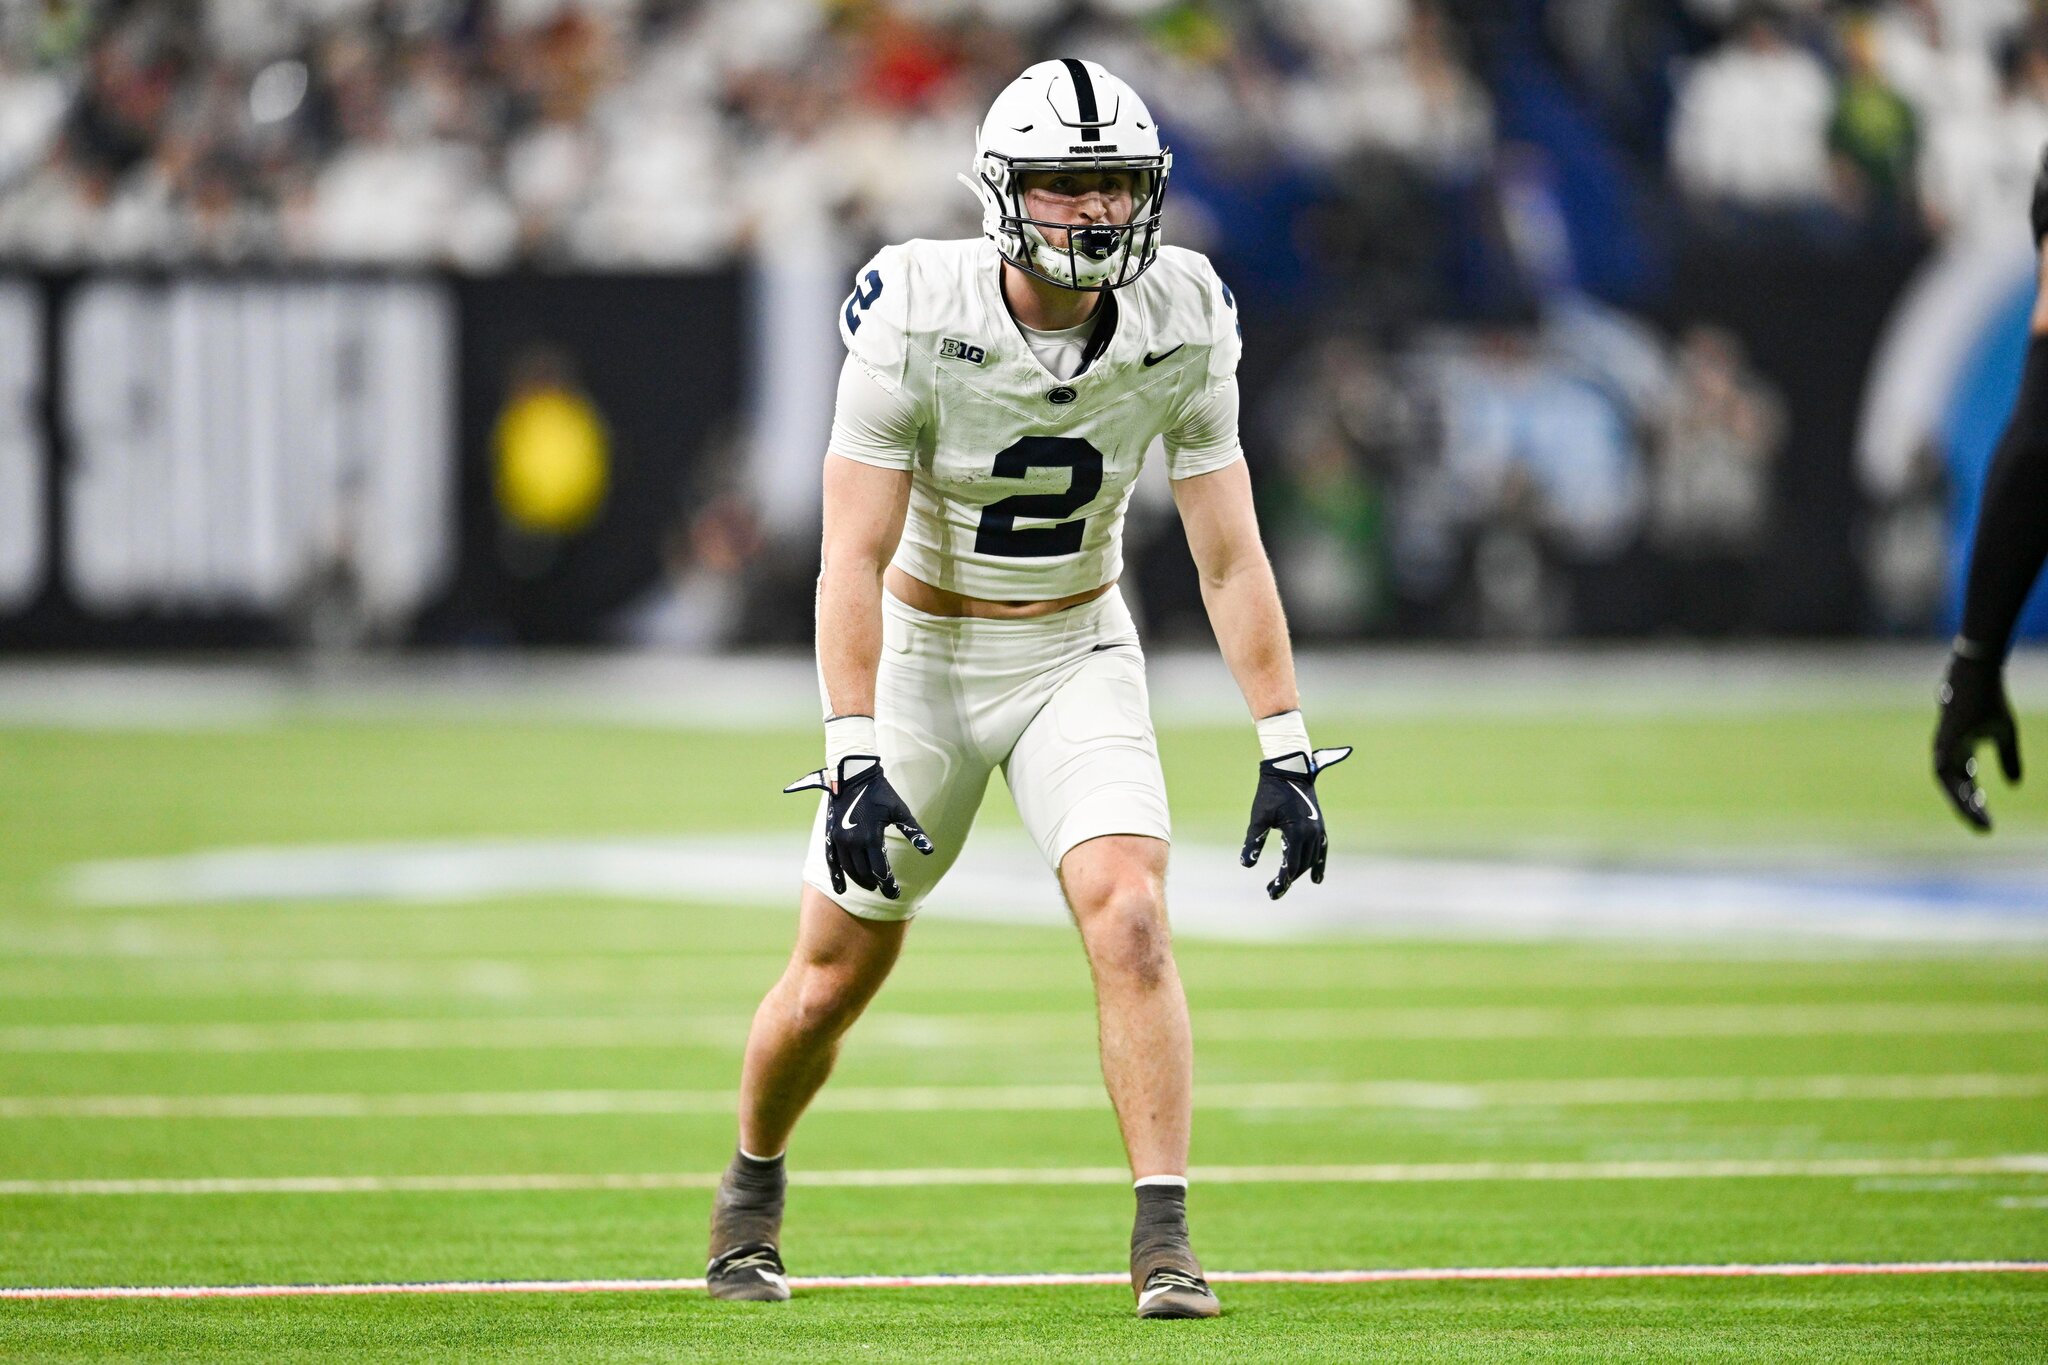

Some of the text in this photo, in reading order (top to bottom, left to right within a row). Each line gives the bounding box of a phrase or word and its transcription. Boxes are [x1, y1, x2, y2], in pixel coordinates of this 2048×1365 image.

[1069, 145, 1118, 154] PENN STATE
[845, 269, 884, 336] 2
[974, 435, 1104, 557] 2
